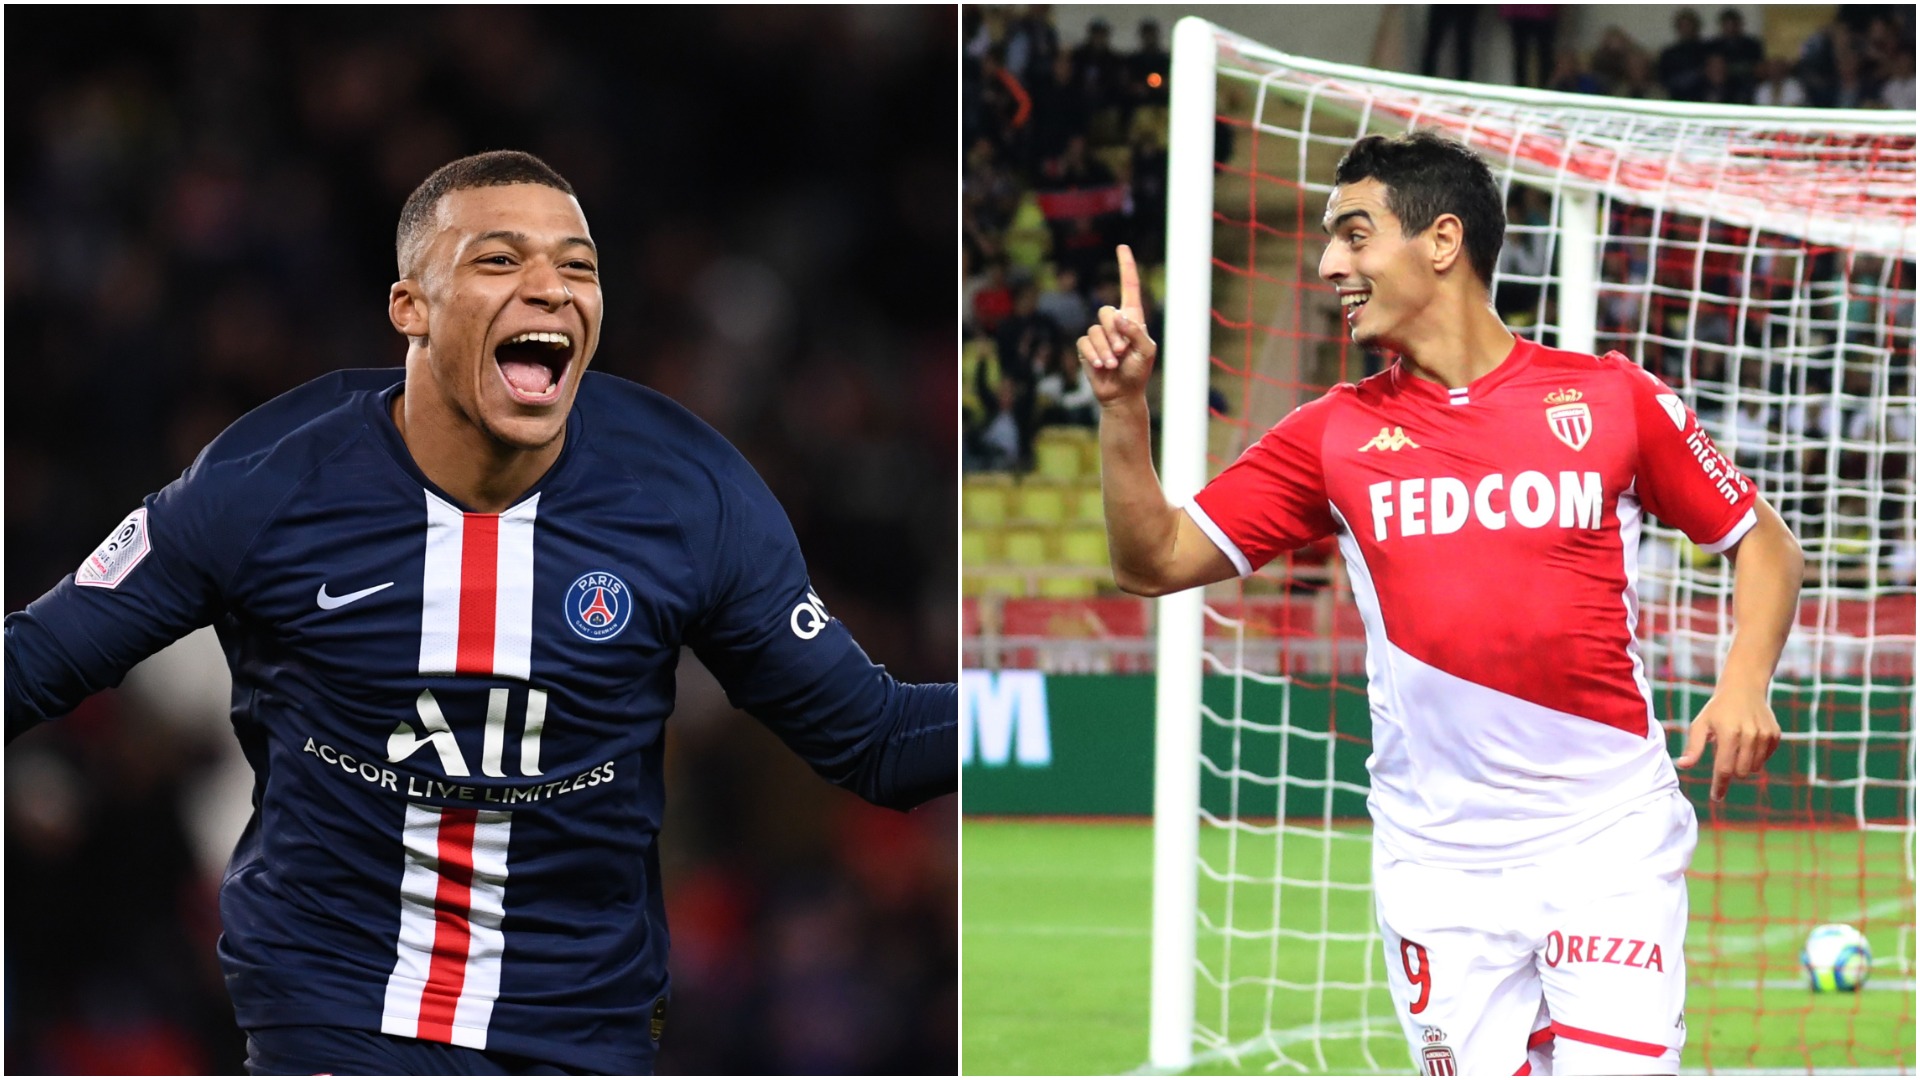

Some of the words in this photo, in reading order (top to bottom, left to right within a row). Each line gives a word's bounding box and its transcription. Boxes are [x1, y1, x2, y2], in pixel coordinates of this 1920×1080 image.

[1369, 470, 1603, 542] FEDCOM
[578, 576, 621, 594] PARIS
[962, 669, 1051, 766] M
[303, 737, 398, 792] ACCOR
[408, 777, 474, 800] LIVE
[485, 761, 615, 803] LIMITLESS
[1401, 937, 1431, 1014] 9
[1545, 930, 1664, 973] OREZZA
